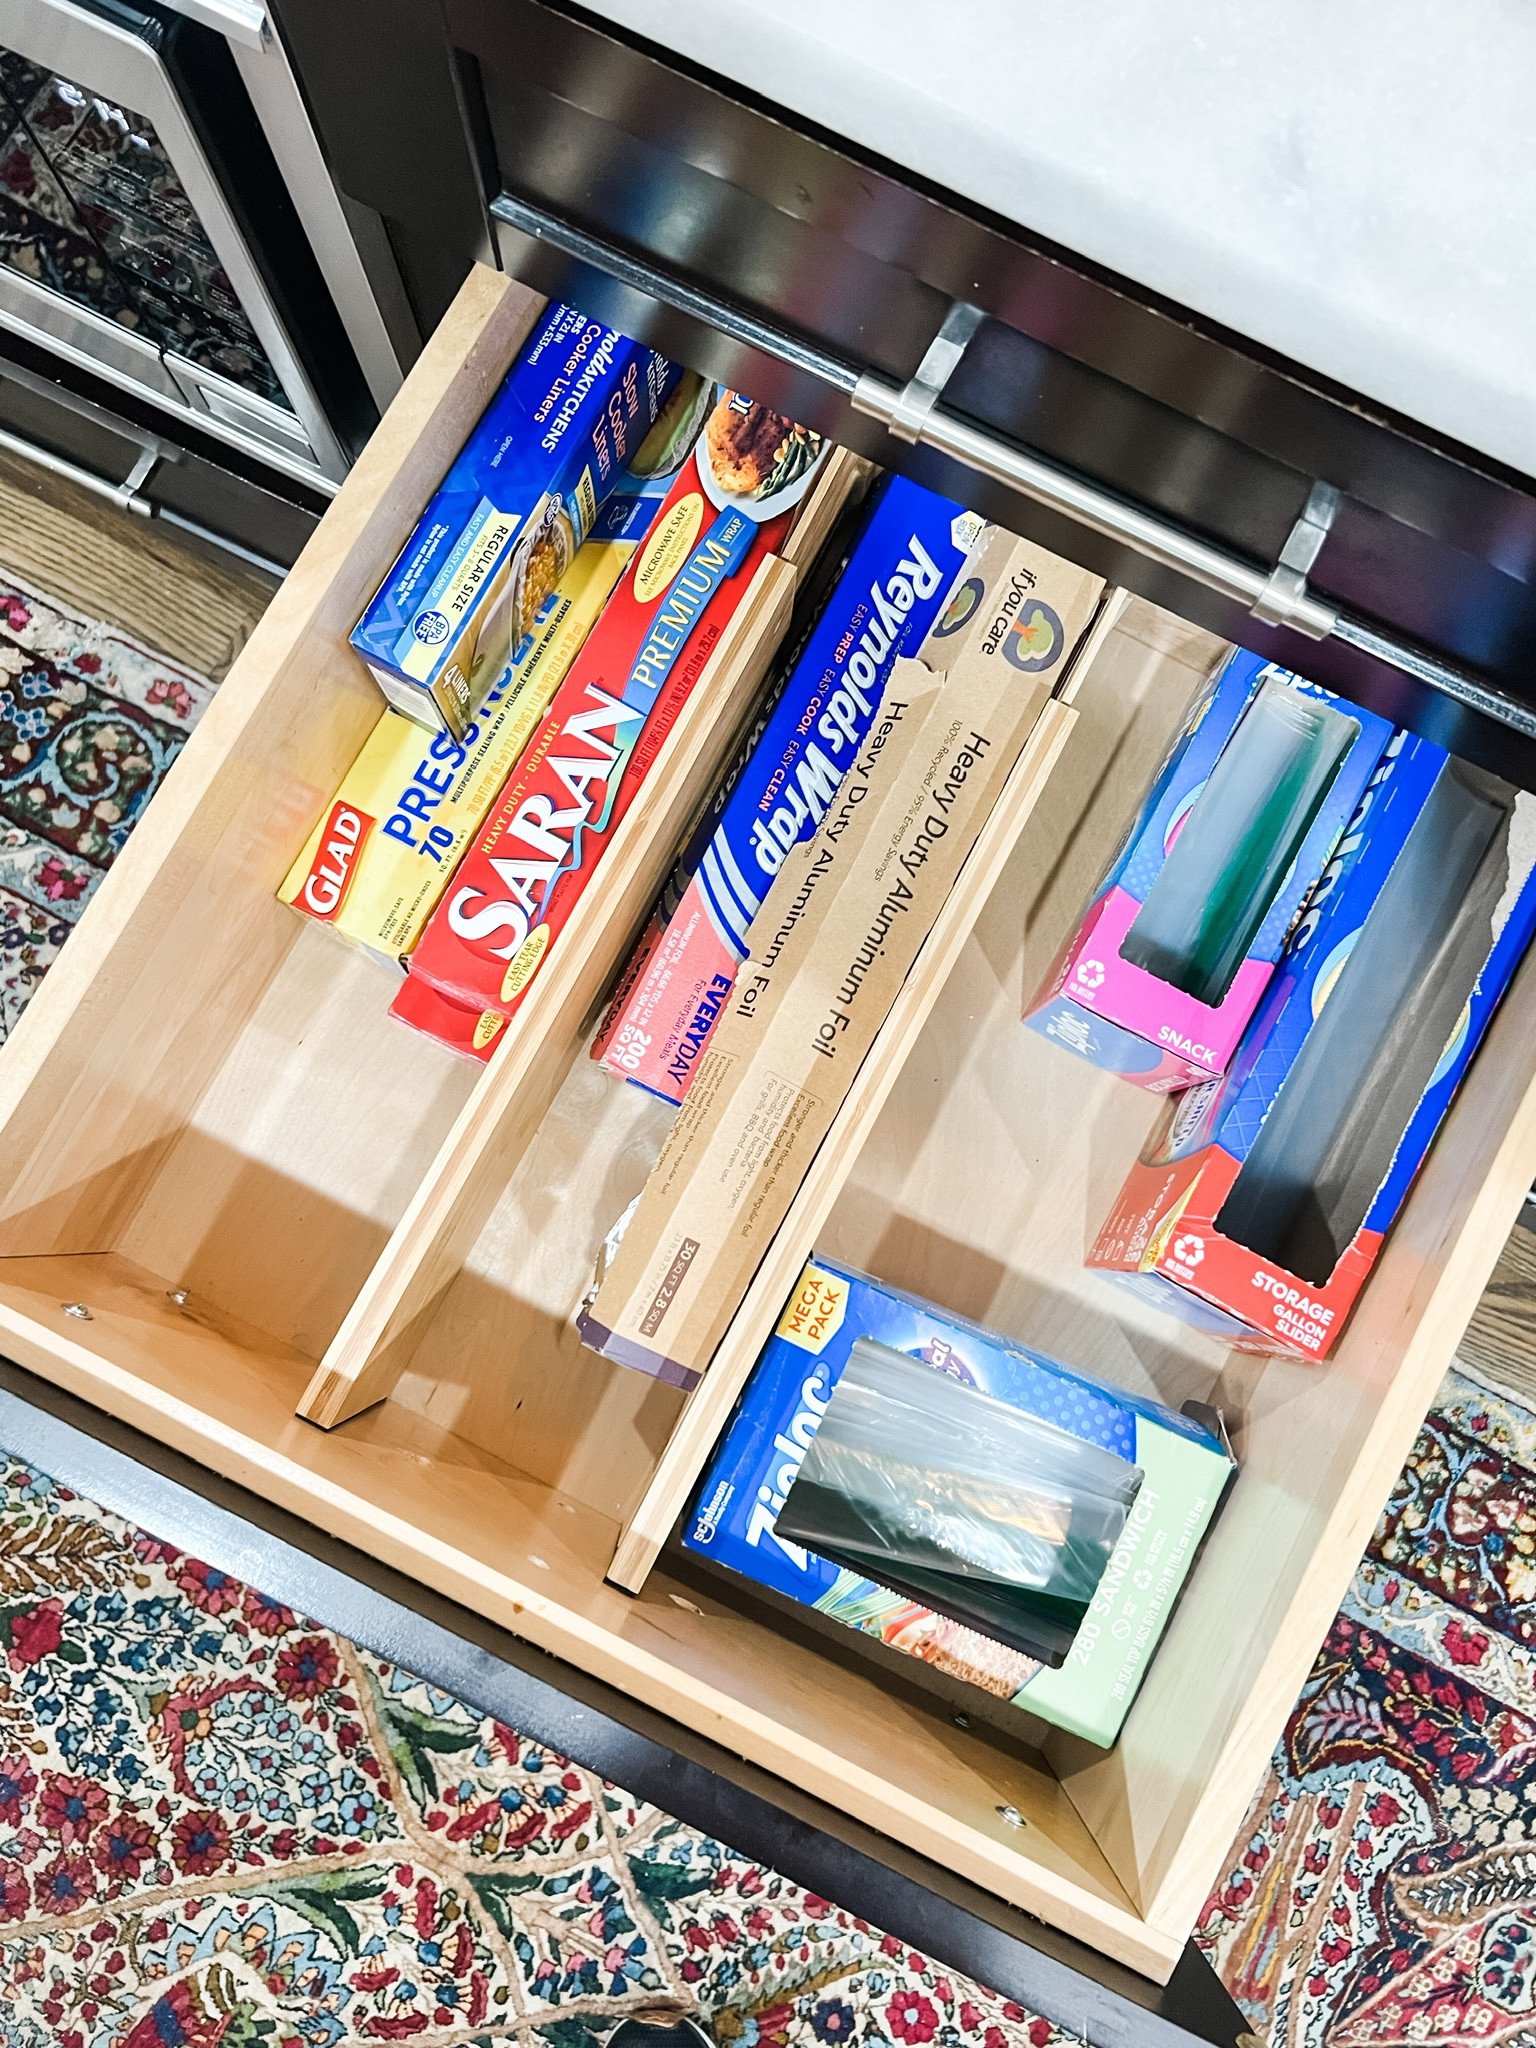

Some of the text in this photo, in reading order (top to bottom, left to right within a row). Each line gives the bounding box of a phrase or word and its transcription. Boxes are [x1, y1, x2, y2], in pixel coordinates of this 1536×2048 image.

[552, 321, 570, 344] 21 IN
[532, 321, 603, 426] Cooker Liners
[622, 362, 639, 418] Slow
[489, 434, 513, 468] OPEN HERE
[592, 414, 611, 481] Liners
[608, 391, 627, 462] Cooker
[429, 511, 484, 599] FAST AND EASY CLEANUP
[639, 504, 689, 585] MICROWAVE SAFE
[953, 518, 968, 536] BOX
[960, 521, 977, 544] OPEN
[406, 577, 417, 591] with
[413, 563, 425, 578] made
[421, 557, 429, 565] is
[450, 533, 488, 591] FITS QUARTS
[450, 524, 508, 613] REGULAR SIZE
[427, 619, 446, 641] BPA
[629, 538, 732, 690] PREMIUM
[719, 515, 743, 545] WRAP
[978, 567, 1039, 657] if you care
[442, 663, 459, 689] 4
[449, 756, 482, 804] MULTIPURPOSE
[476, 729, 497, 758] SEALING
[491, 711, 507, 731] WRAP
[504, 676, 527, 710] PELLICULE
[542, 597, 573, 644] MULTI-USAGES
[749, 533, 944, 877] Reynolds Wrap
[755, 602, 869, 812] EASY PREP EASY COOK EASY CLEAN
[854, 703, 908, 780] Heavy
[479, 719, 562, 855] HEAVY DUTY DURABLE
[872, 717, 963, 883] 100% Recycled 95% Energy Savings
[933, 730, 991, 814] Heavy
[454, 681, 646, 961] SARAN
[823, 779, 869, 845] Duty
[297, 806, 365, 916] GLAD
[417, 822, 456, 865] 70
[893, 811, 950, 881] Duty
[761, 847, 827, 968] Aluminum
[507, 939, 535, 982] EASY TEAR
[510, 935, 546, 993] CUTTING EDGE
[665, 927, 682, 948] 18.58
[836, 877, 908, 1003] Aluminum
[595, 946, 653, 1043] EVERYDAY
[637, 910, 701, 1027] ALUMINUM FOIL 66.66 YDS 12 IN
[649, 956, 667, 979] (60.96
[735, 972, 770, 1021] Foil
[608, 1022, 635, 1063] SQ FT
[658, 977, 706, 1062] For Everyday Meals
[662, 973, 734, 1086] EVERYDAY
[809, 1007, 852, 1059] Foil
[1155, 1023, 1218, 1066] SNACK
[617, 1027, 653, 1072] 200
[717, 1077, 777, 1184] For BBQ and oven use
[738, 1082, 788, 1168] humidity and bacteria
[760, 1092, 805, 1168] Excellent food wrap
[762, 1120, 778, 1140] food
[772, 1087, 795, 1122] Protects
[739, 1097, 816, 1238] Stronger and thicker than regular foil
[752, 1138, 769, 1160] from
[642, 1240, 696, 1333] 30 SQ FT 2.8 SQ M
[787, 1278, 824, 1336] MEGA
[808, 1287, 841, 1342] PACK
[1248, 1268, 1337, 1327] STORAGE
[1269, 1301, 1328, 1340] GALLON
[1273, 1317, 1322, 1352] SLIDER
[1068, 1487, 1161, 1667] 280 SANDWICH
[1124, 1645, 1143, 1665] TOP
[1131, 1624, 1152, 1648] BAGS
[1108, 1681, 1128, 1701] 280
[1116, 1661, 1136, 1684] SEAL
